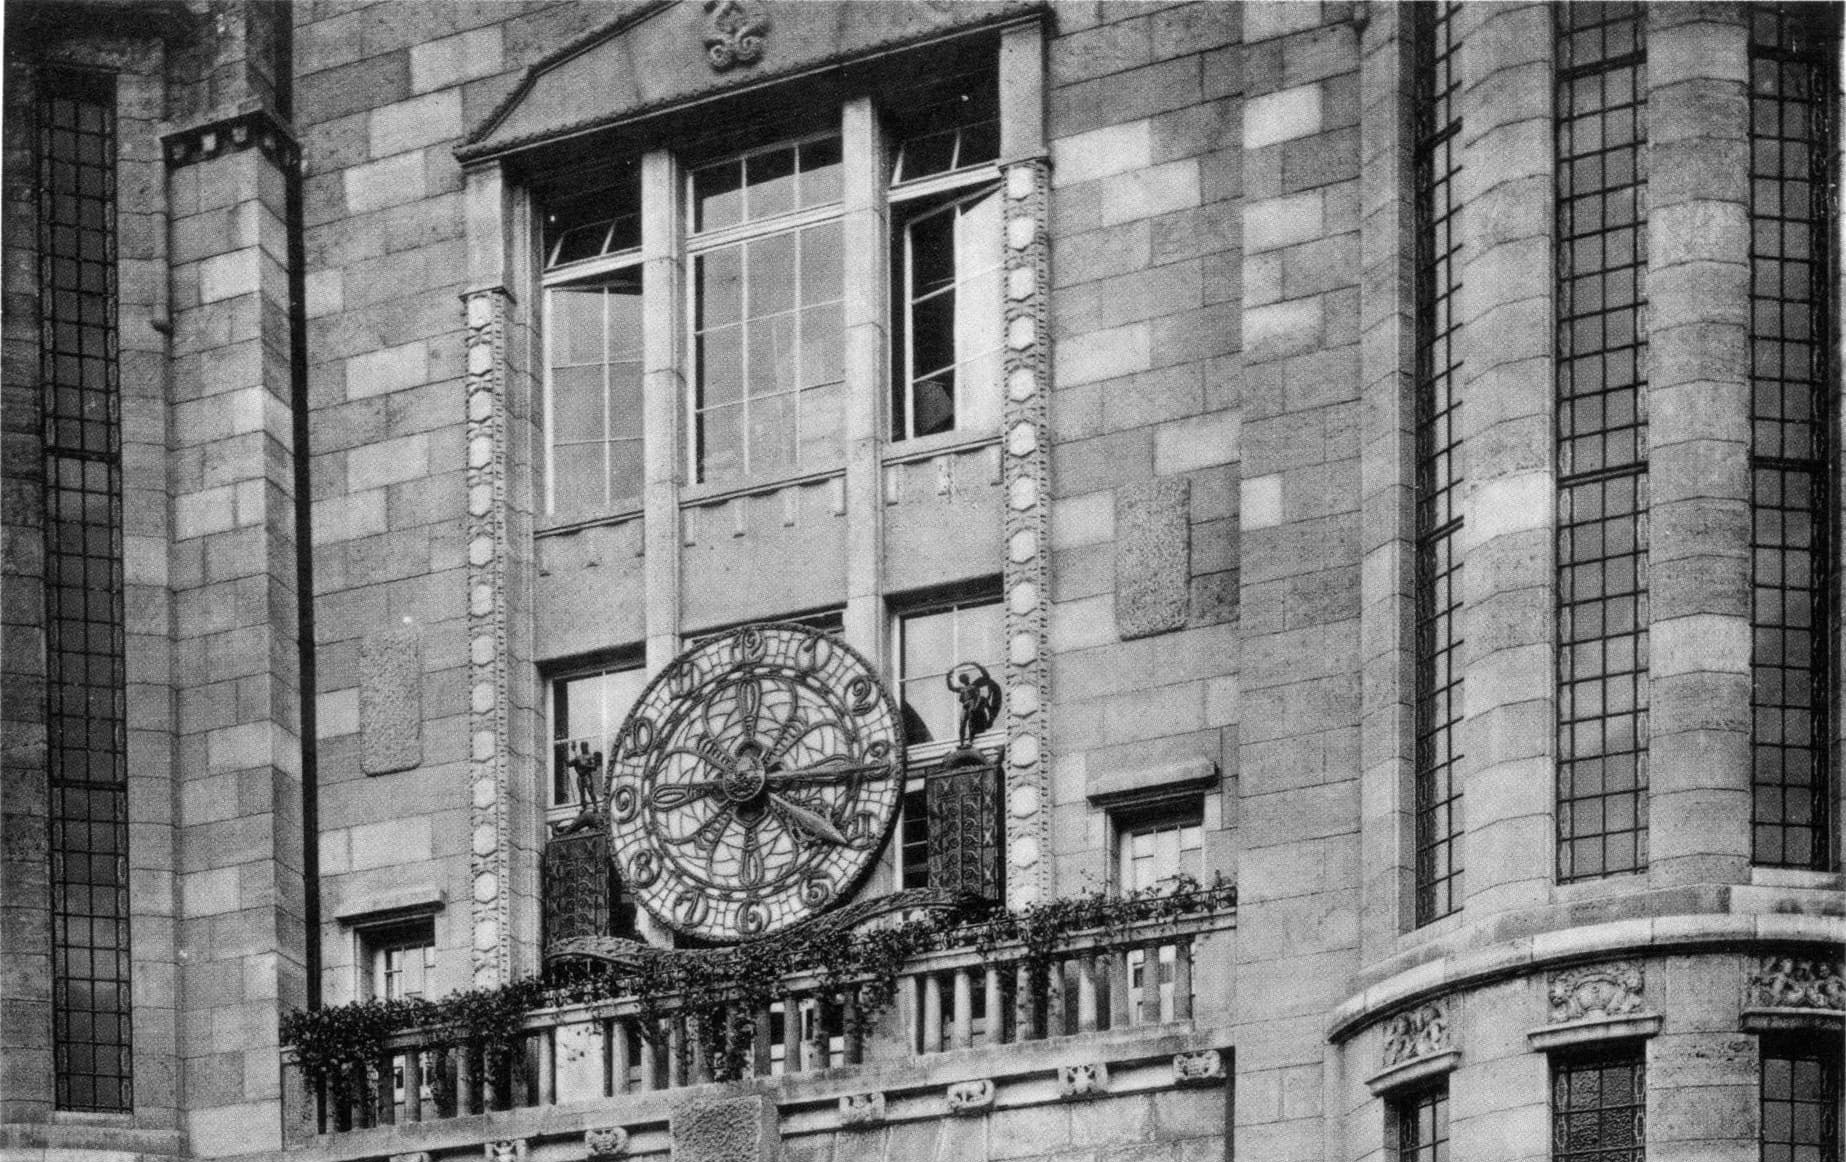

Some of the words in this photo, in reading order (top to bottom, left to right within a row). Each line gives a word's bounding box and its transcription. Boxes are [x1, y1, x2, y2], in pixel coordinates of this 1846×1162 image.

[850, 676, 872, 715] 2
[614, 787, 637, 823] 9
[632, 850, 655, 887] 8
[673, 889, 700, 924] 7
[740, 902, 764, 935] 6
